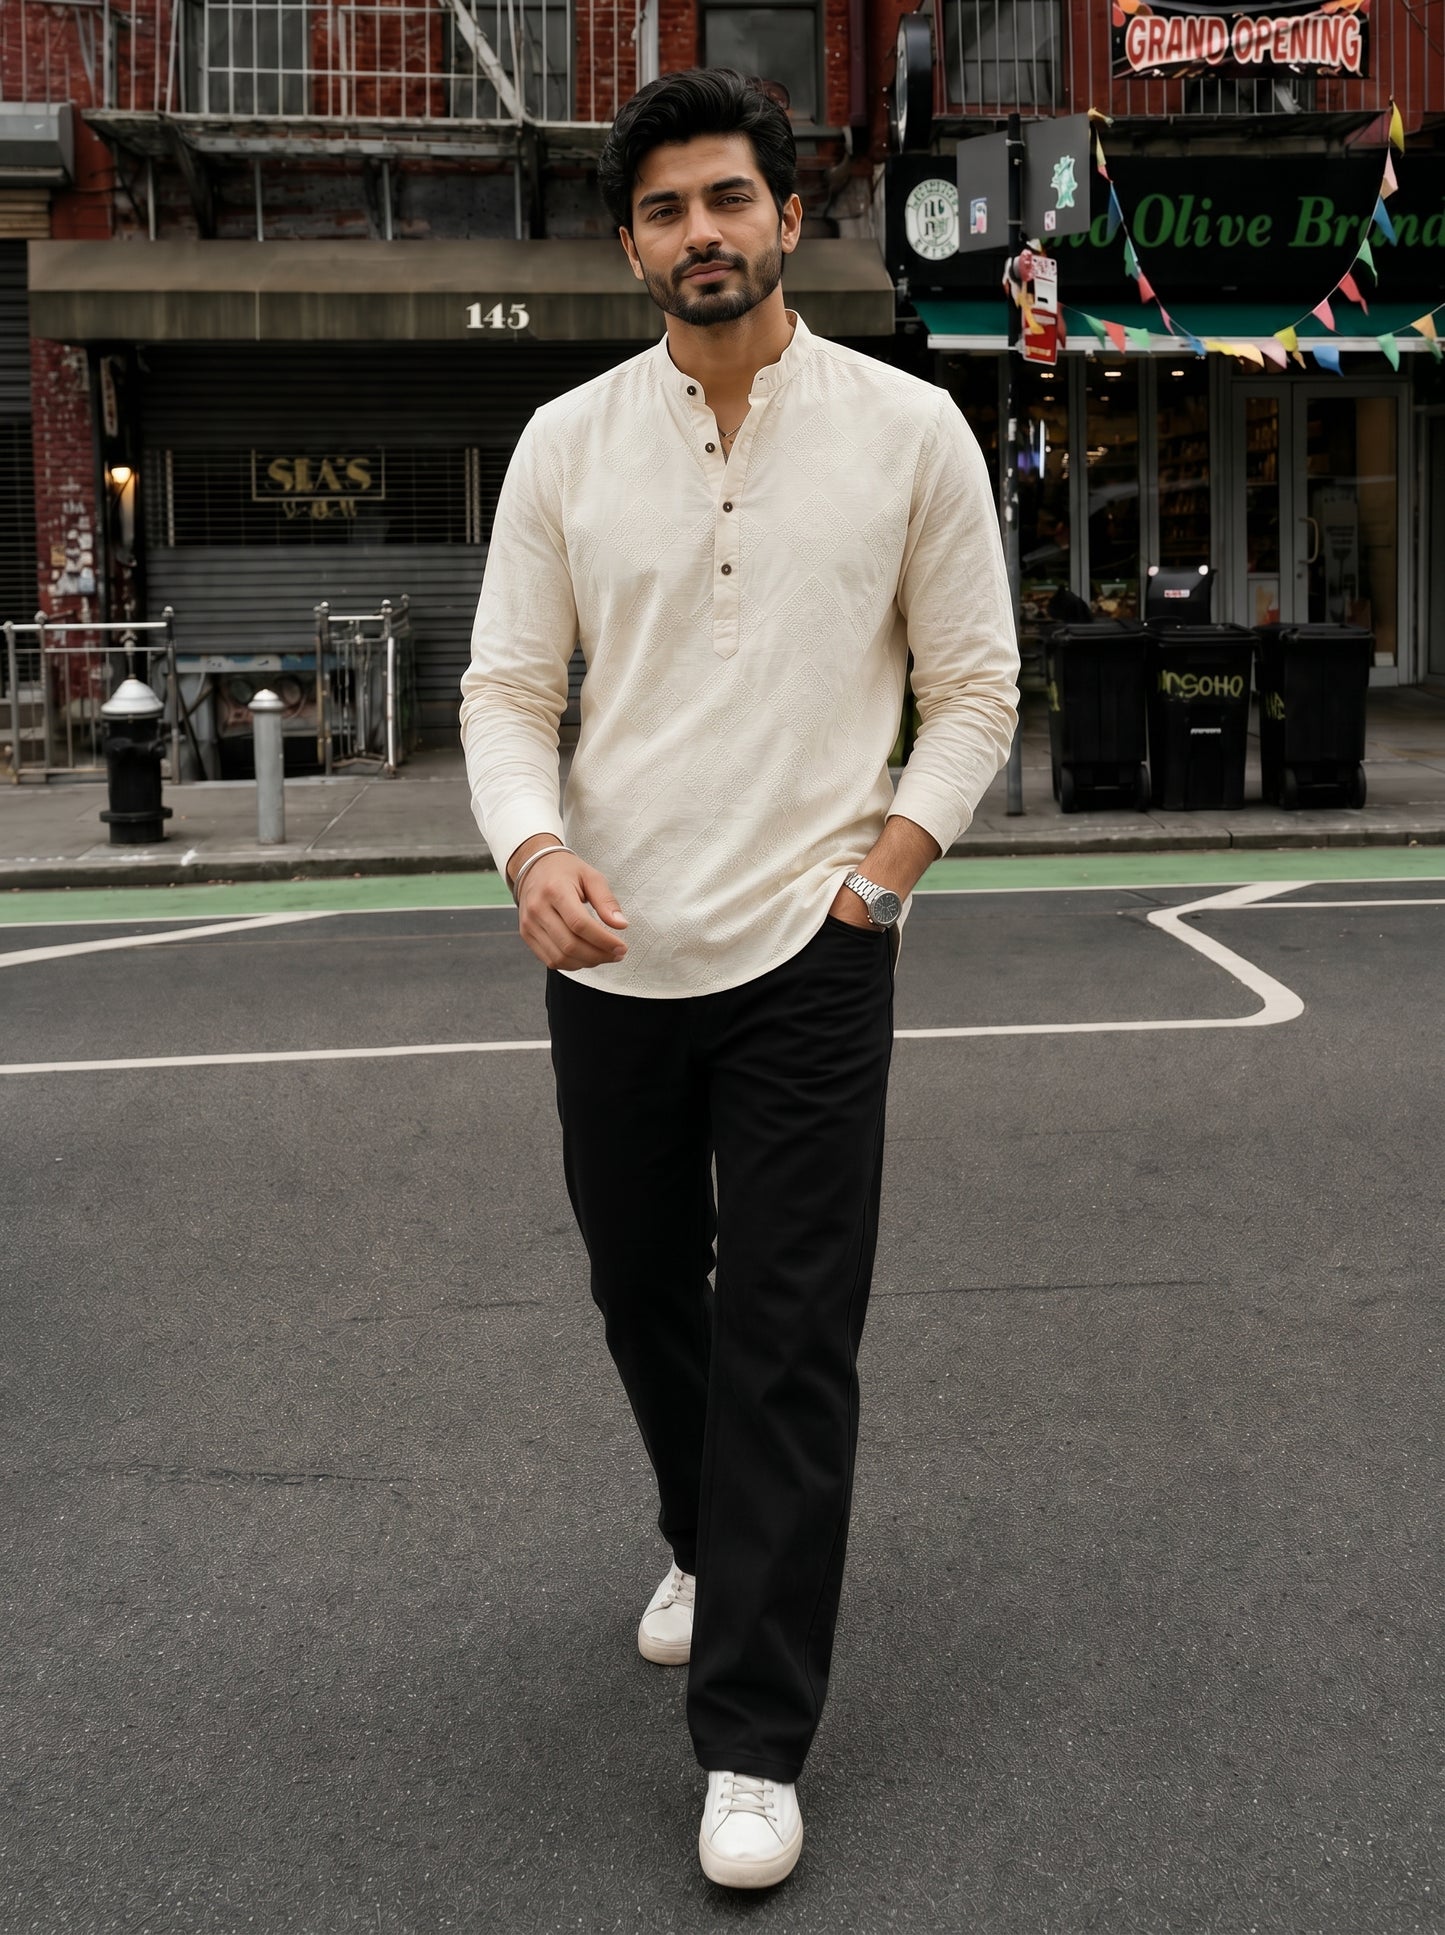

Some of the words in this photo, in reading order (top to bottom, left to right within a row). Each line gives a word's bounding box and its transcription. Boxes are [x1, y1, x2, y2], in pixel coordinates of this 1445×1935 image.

[1126, 16, 1229, 71] GRAND
[1231, 15, 1361, 71] OPENING
[1133, 193, 1272, 248] Olive
[466, 302, 530, 330] 145
